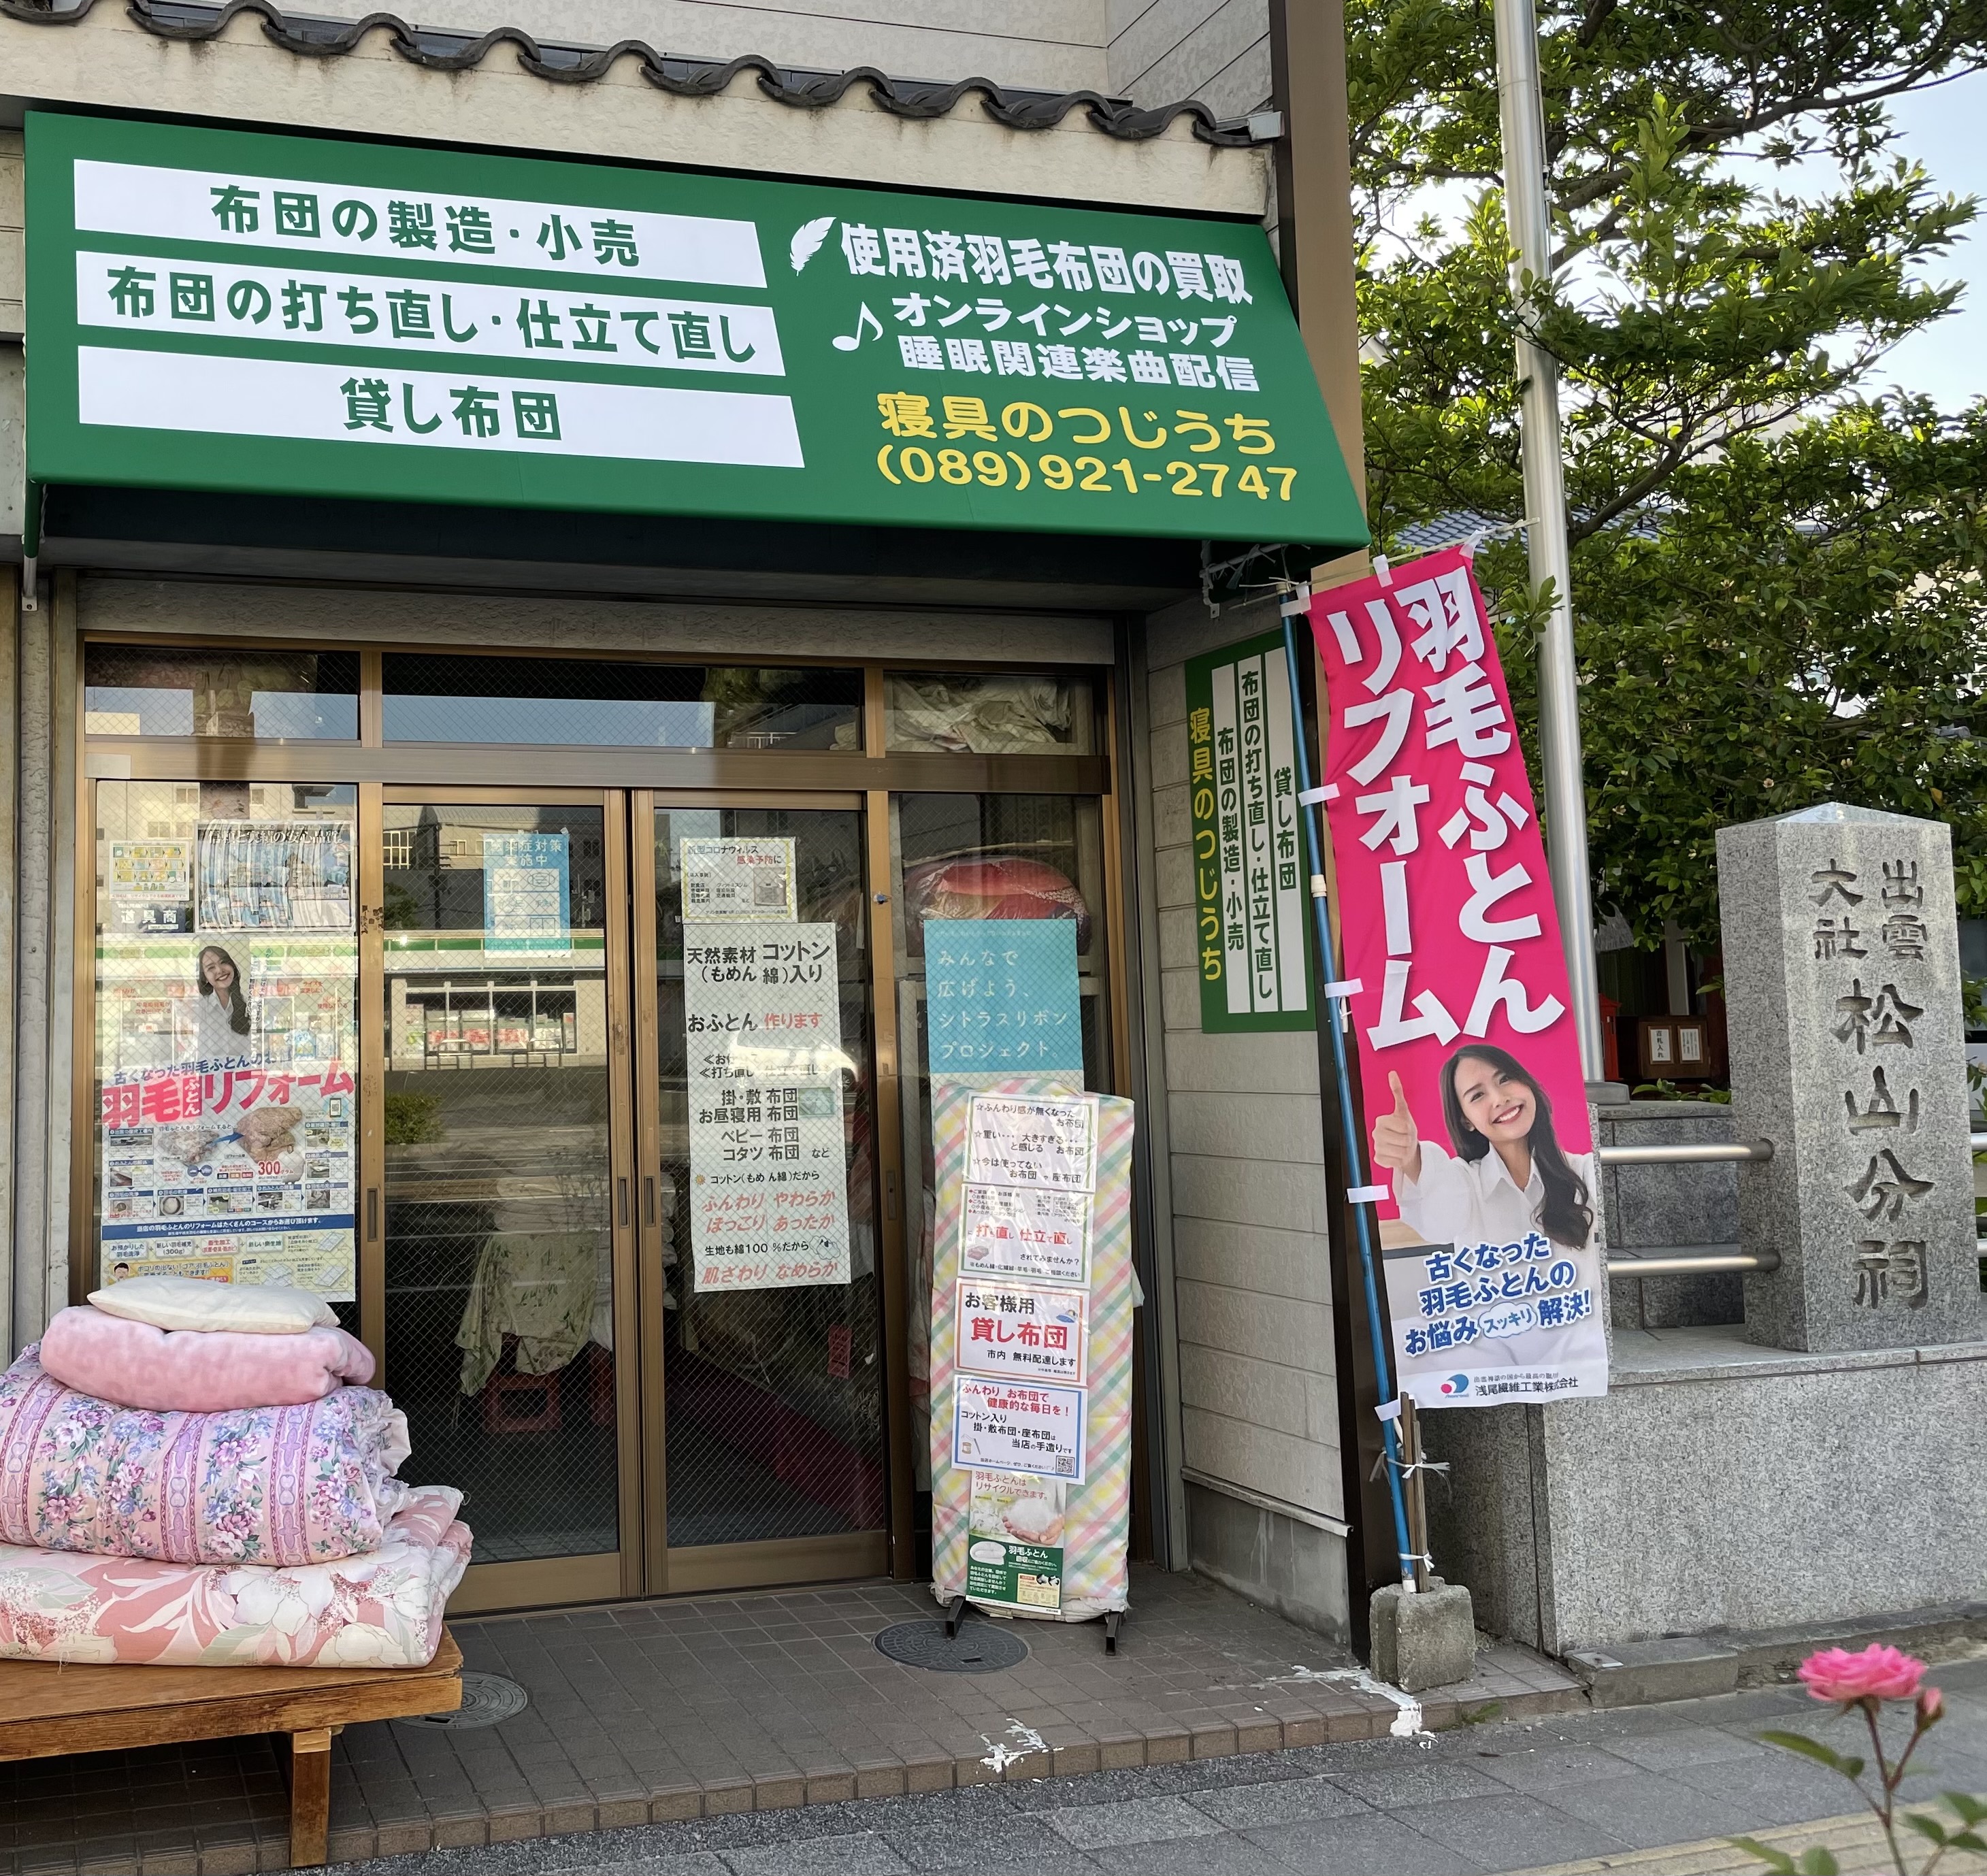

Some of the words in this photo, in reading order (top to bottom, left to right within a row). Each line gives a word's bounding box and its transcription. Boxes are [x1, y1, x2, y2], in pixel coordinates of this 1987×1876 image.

[210, 184, 639, 268] 布団の製造・小売
[841, 222, 1253, 305] 使用済羽毛布団の買取
[107, 265, 755, 363] 布団の打ち直し・仕立て直し
[892, 293, 1238, 348] オンラインショップ
[898, 335, 1260, 392] 睡眠関連楽曲配信
[341, 376, 561, 441] 貸し布団
[877, 391, 1275, 456] 寝具のつじうち
[1394, 565, 1565, 1038] 羽毛ふとん
[1241, 670, 1273, 999] 布団の打ち直し・仕立て直し
[1274, 767, 1296, 891] 貸し布団
[1326, 598, 1461, 1051] リフォーム
[1189, 708, 1221, 981] 寝具のつじうち
[1217, 727, 1245, 951] 布団の製造・小売
[687, 947, 757, 964] 天然素材
[763, 941, 830, 962] コットン
[938, 951, 1019, 966] みんなで
[688, 1013, 758, 1033] おふとん
[763, 1012, 823, 1030] 作ります
[940, 1010, 1067, 1028] シトラスリボン
[721, 1089, 761, 1106] 掛・敷
[767, 1088, 798, 1105] 布団
[699, 1107, 761, 1123] お昼寝用
[767, 1106, 799, 1122] 布団
[1056, 1118, 1084, 1128] お布団
[721, 1128, 763, 1144] ベビー
[768, 1127, 800, 1144] 布団
[1830, 978, 1935, 1311] 松山分祠
[723, 1146, 762, 1162] コタツ
[768, 1145, 800, 1161] 布団
[812, 1147, 830, 1158] など
[1011, 1142, 1043, 1153] と感じる
[1056, 1147, 1084, 1156] お布団
[1010, 1170, 1037, 1180] お布団
[1052, 1173, 1081, 1183] 座布団
[702, 1192, 766, 1213] ふんわり
[774, 1191, 836, 1210] やわらか
[706, 1215, 767, 1234] ほっこり
[773, 1215, 835, 1232] あったか
[1426, 1232, 1549, 1282] 古くなった
[702, 1264, 768, 1285] 肌さわり
[776, 1262, 838, 1282] なめらか
[1419, 1261, 1575, 1315] 羽毛ふとんの
[965, 1292, 1034, 1315] お客様用
[971, 1317, 1068, 1350] 貸し布団
[1405, 1317, 1478, 1355] お悩み
[1484, 1308, 1532, 1332] スッキリ
[987, 1350, 1006, 1360] 市内
[1013, 1352, 1076, 1367] 無料配達します
[962, 1383, 1000, 1396] ふんわり
[1007, 1389, 1049, 1402] お布団で
[961, 1411, 1007, 1423] コットン入り
[1012, 1438, 1072, 1453] 当店の手造りです
[975, 1470, 1027, 1486] 羽毛ふとんは
[1008, 1545, 1048, 1558] 羽毛ふとん
